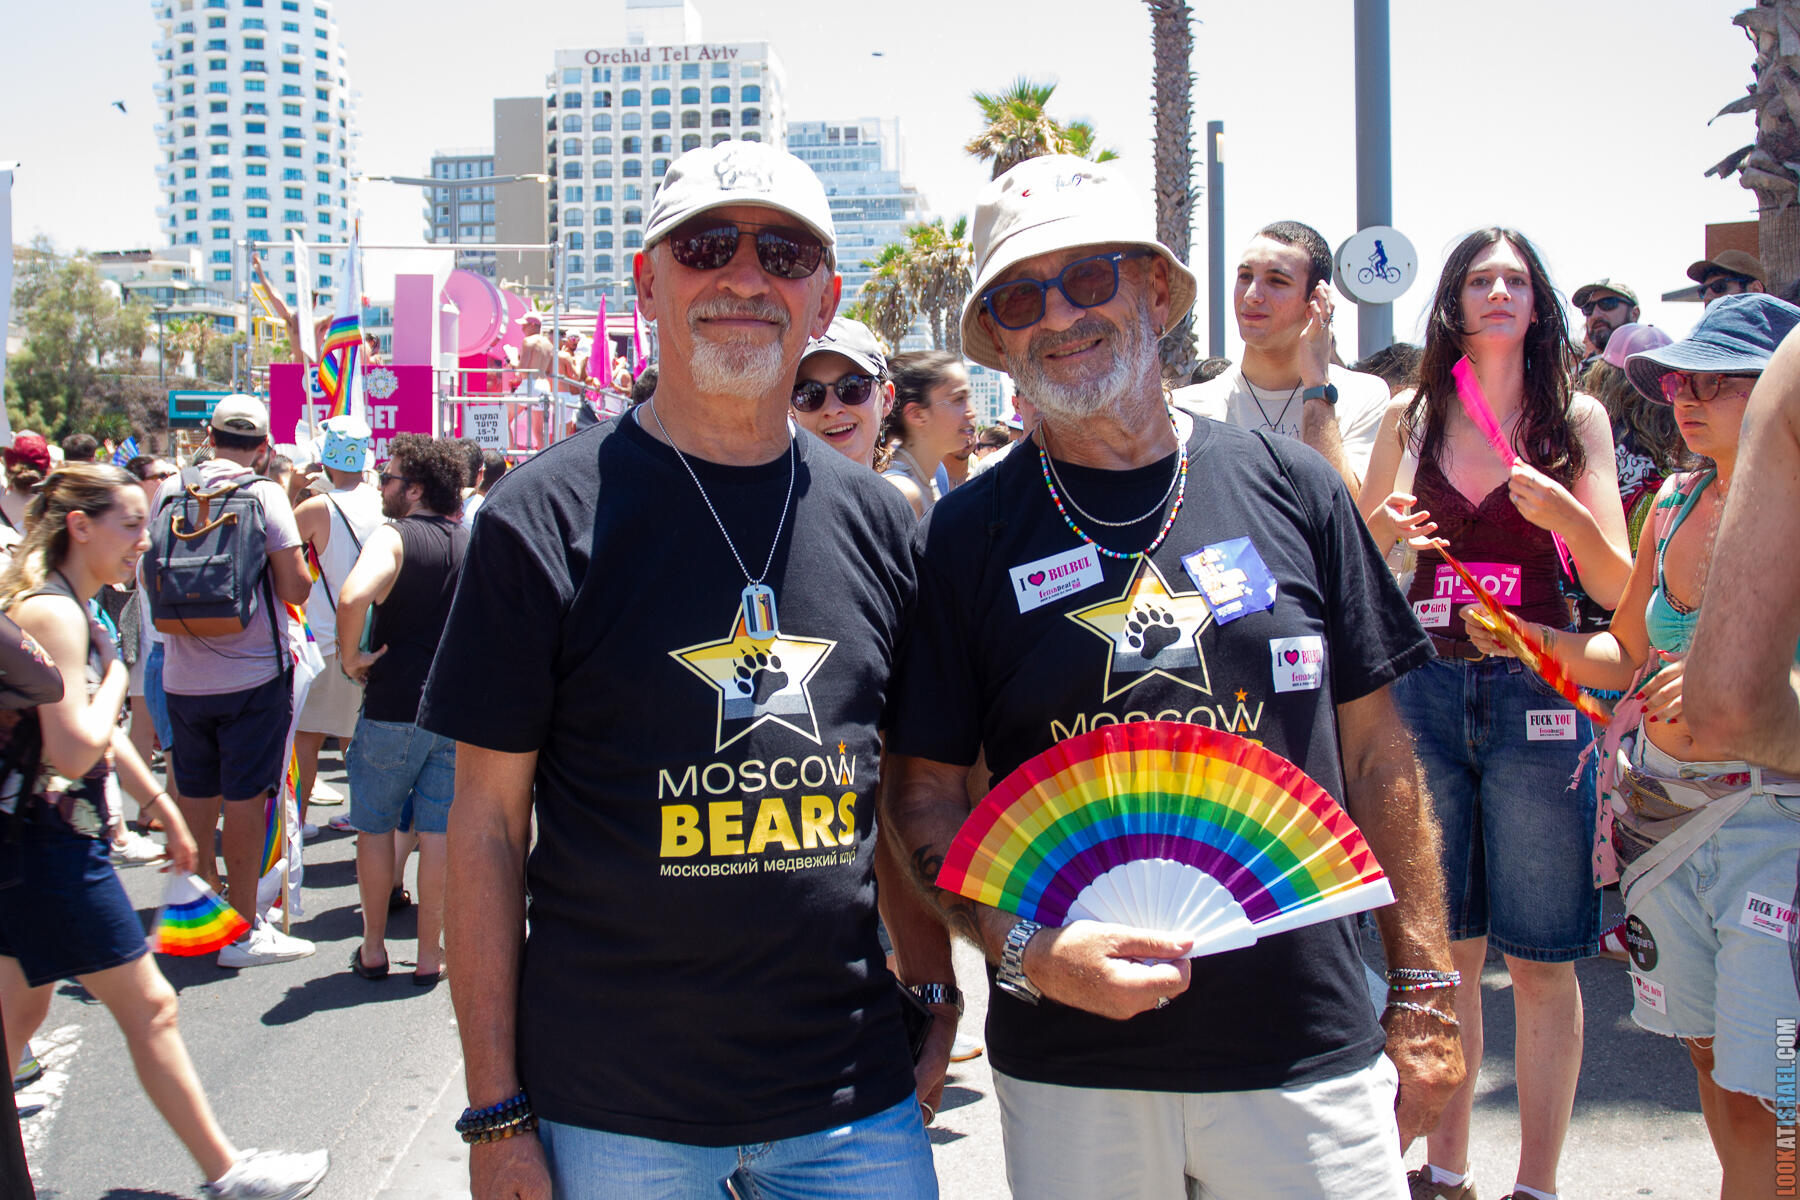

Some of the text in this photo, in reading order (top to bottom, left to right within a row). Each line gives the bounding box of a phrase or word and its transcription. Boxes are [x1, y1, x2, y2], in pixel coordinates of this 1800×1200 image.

[584, 45, 738, 64] Orchid Tel Aviv
[1048, 556, 1091, 581] BULBUL
[1531, 714, 1571, 726] FUCK YOU
[658, 755, 856, 799] MOSCOW
[659, 792, 857, 857] BEARS
[660, 858, 758, 877] московский
[763, 851, 837, 873] медвежий
[1748, 897, 1774, 916] FUCK
